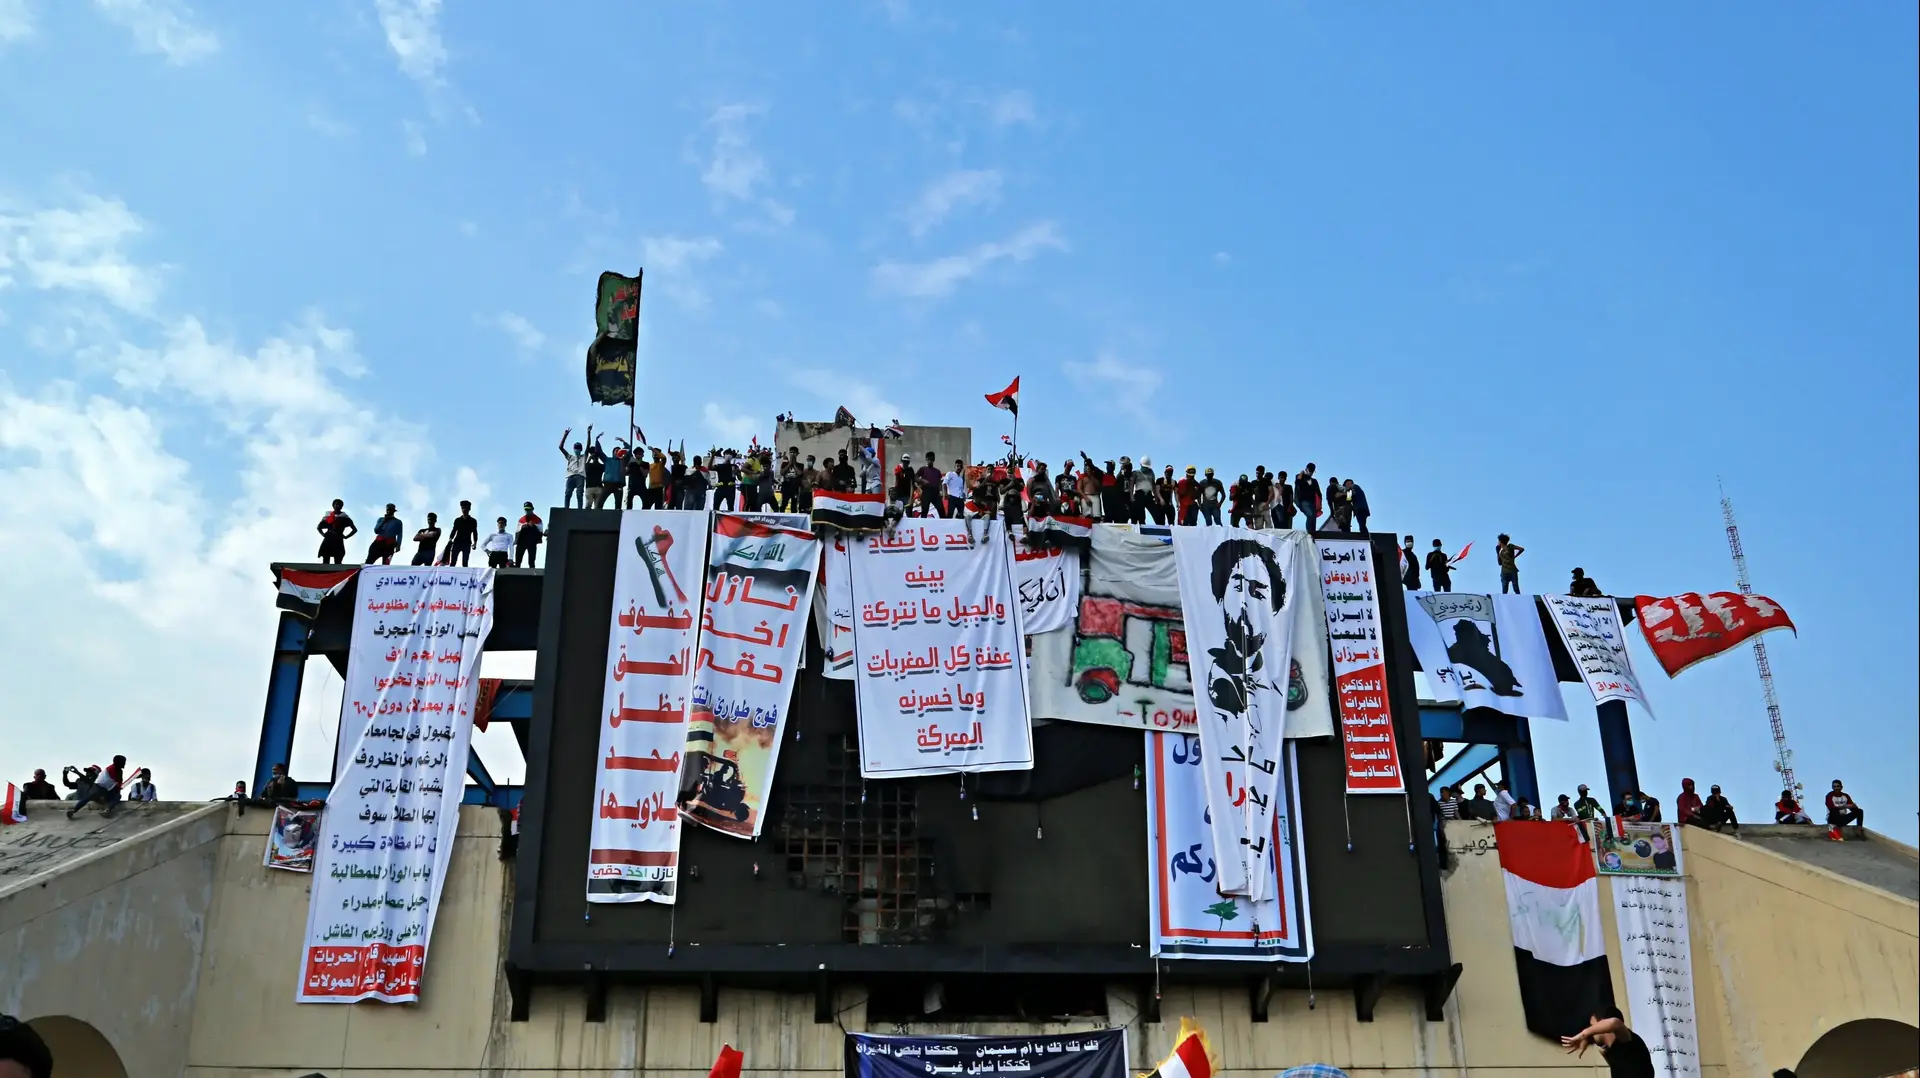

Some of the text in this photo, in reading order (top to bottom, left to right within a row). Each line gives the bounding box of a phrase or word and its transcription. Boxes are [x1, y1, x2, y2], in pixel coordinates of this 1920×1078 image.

[920, 527, 940, 547] ما
[1321, 547, 1366, 564] لا امريكا
[905, 565, 945, 590] بينه
[1324, 569, 1369, 585] لا اردوغان
[705, 572, 799, 612] نازل
[1326, 588, 1373, 604] لا سعودية
[367, 598, 409, 614] مظلومية
[862, 595, 1006, 627] والجبل ما نتركة
[1329, 608, 1373, 623] لا ايران
[373, 620, 420, 640] المتعجرف
[1331, 627, 1377, 643] لا للبعث
[943, 645, 970, 670] كل
[975, 646, 1012, 667] عفنة
[1372, 646, 1379, 660] لا
[613, 644, 691, 682] الحق
[1375, 679, 1381, 690] لا
[378, 698, 402, 715] دون
[899, 684, 985, 712] وما خسرنه
[1345, 696, 1381, 710] المخابرات
[609, 692, 685, 729] تظل
[713, 697, 751, 725] طوارئ
[752, 703, 778, 727] فوج
[1343, 713, 1388, 727] الاسرائيلية
[406, 725, 421, 743] في
[917, 722, 983, 750] المعركة
[1346, 731, 1390, 743] دعاة
[605, 745, 681, 774] محد
[1350, 748, 1390, 762] المدنية
[1348, 765, 1396, 779] الكاذبة
[359, 778, 385, 799] التي
[358, 803, 388, 825] سوف
[599, 788, 677, 830] يلاويها
[331, 834, 376, 853] كبيرة
[330, 863, 382, 883] للمطالبة
[592, 865, 674, 881] نازل اخذ حقي
[323, 923, 358, 943] الفاشل
[314, 949, 362, 966] الحريات
[309, 974, 360, 991] العمولات
[855, 1040, 1099, 1060] تك تك تك يا أم سليمان تكتكنا بنص النيران
[925, 1059, 1030, 1076] تكتكنا شايل غيرة
